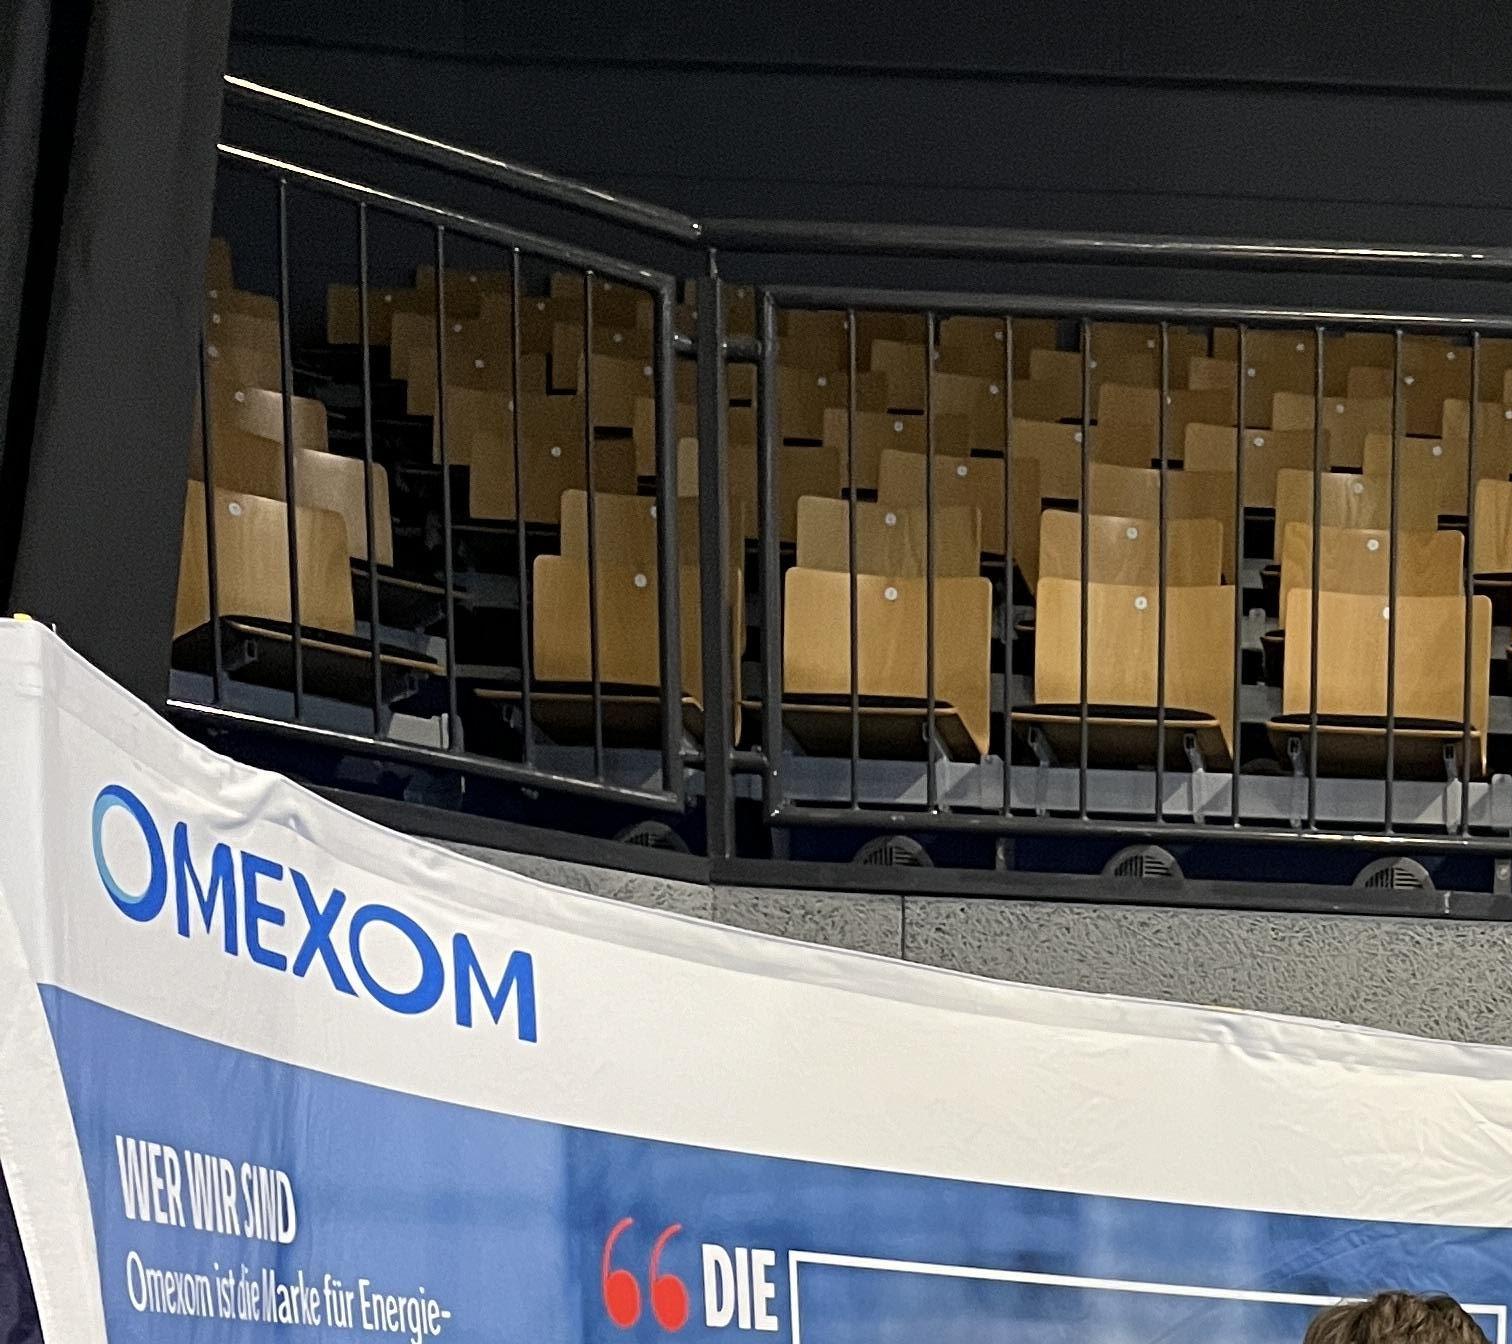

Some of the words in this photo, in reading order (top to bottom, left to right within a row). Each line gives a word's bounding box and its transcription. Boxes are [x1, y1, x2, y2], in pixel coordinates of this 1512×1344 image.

[92, 784, 538, 1043] OMEXOM
[115, 1135, 186, 1228] WER
[184, 1150, 241, 1236] WIR
[241, 1162, 297, 1245] SIND
[126, 1251, 214, 1318] Omexom
[214, 1262, 236, 1320] ist
[238, 1264, 260, 1322] die
[262, 1268, 321, 1326] Marke
[323, 1273, 354, 1329] für
[701, 1243, 779, 1332] DIE
